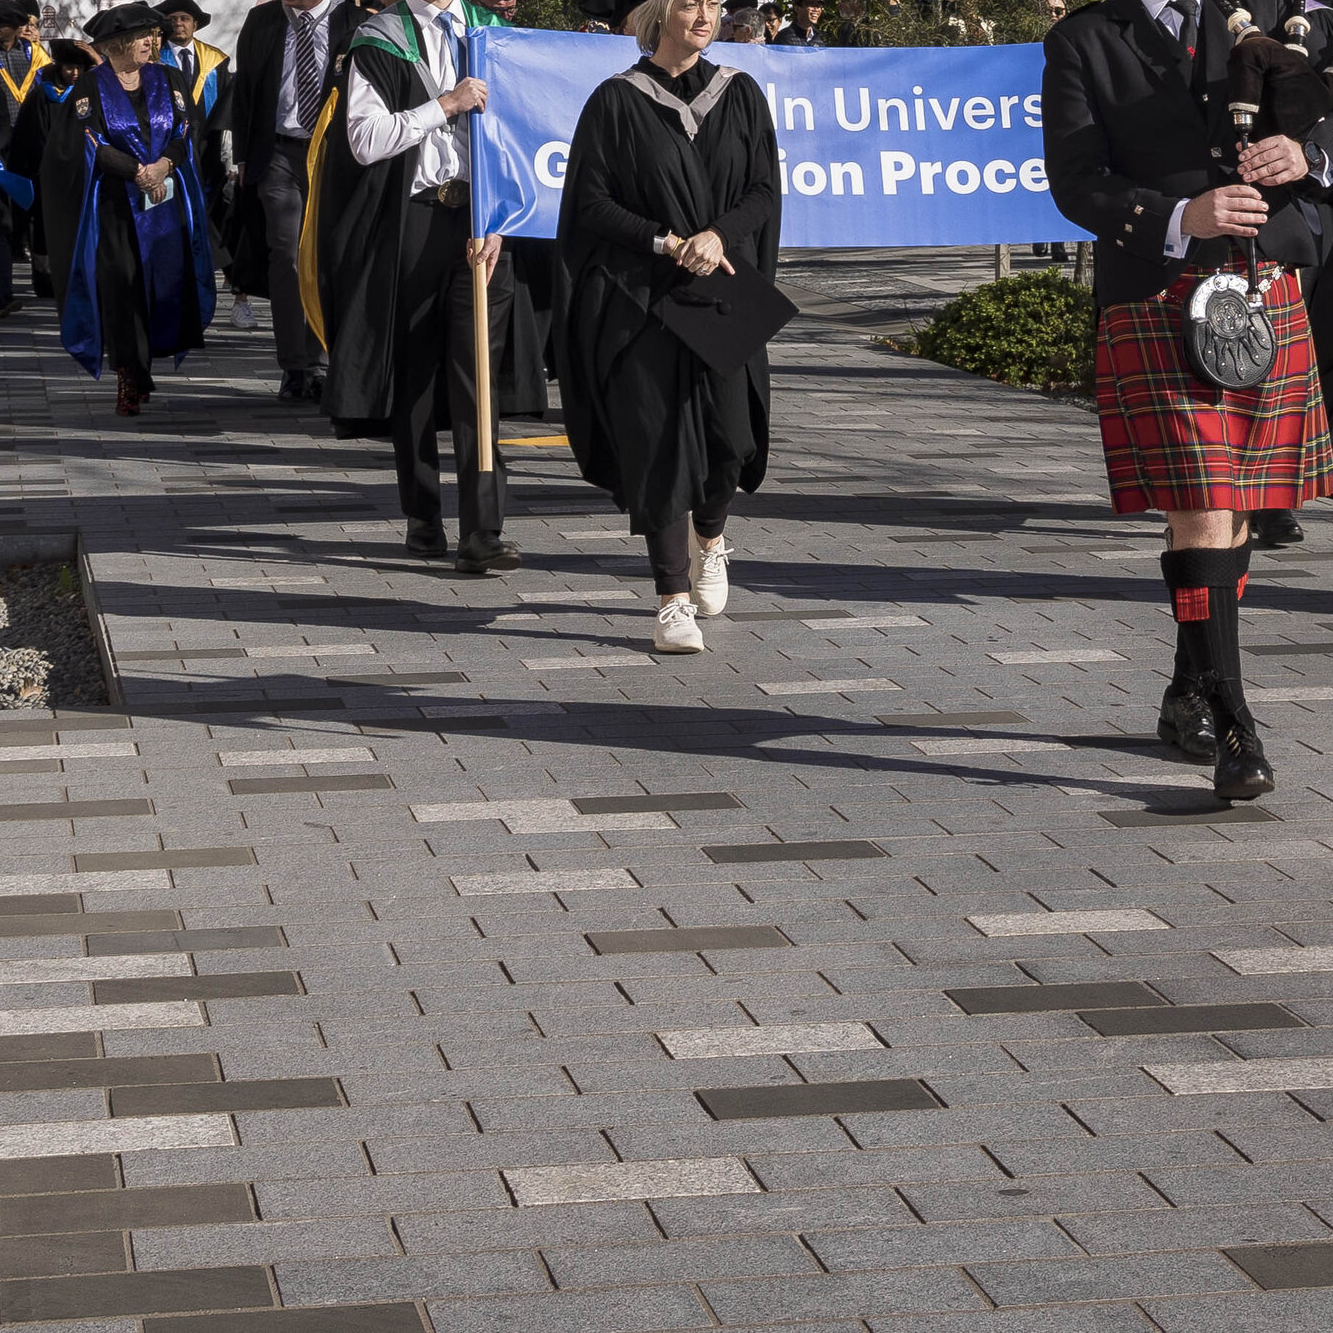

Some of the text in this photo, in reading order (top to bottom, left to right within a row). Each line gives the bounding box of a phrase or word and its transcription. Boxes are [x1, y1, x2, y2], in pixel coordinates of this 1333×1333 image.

[834, 85, 1043, 132] Univers
[534, 140, 1050, 195] G ion Proce
